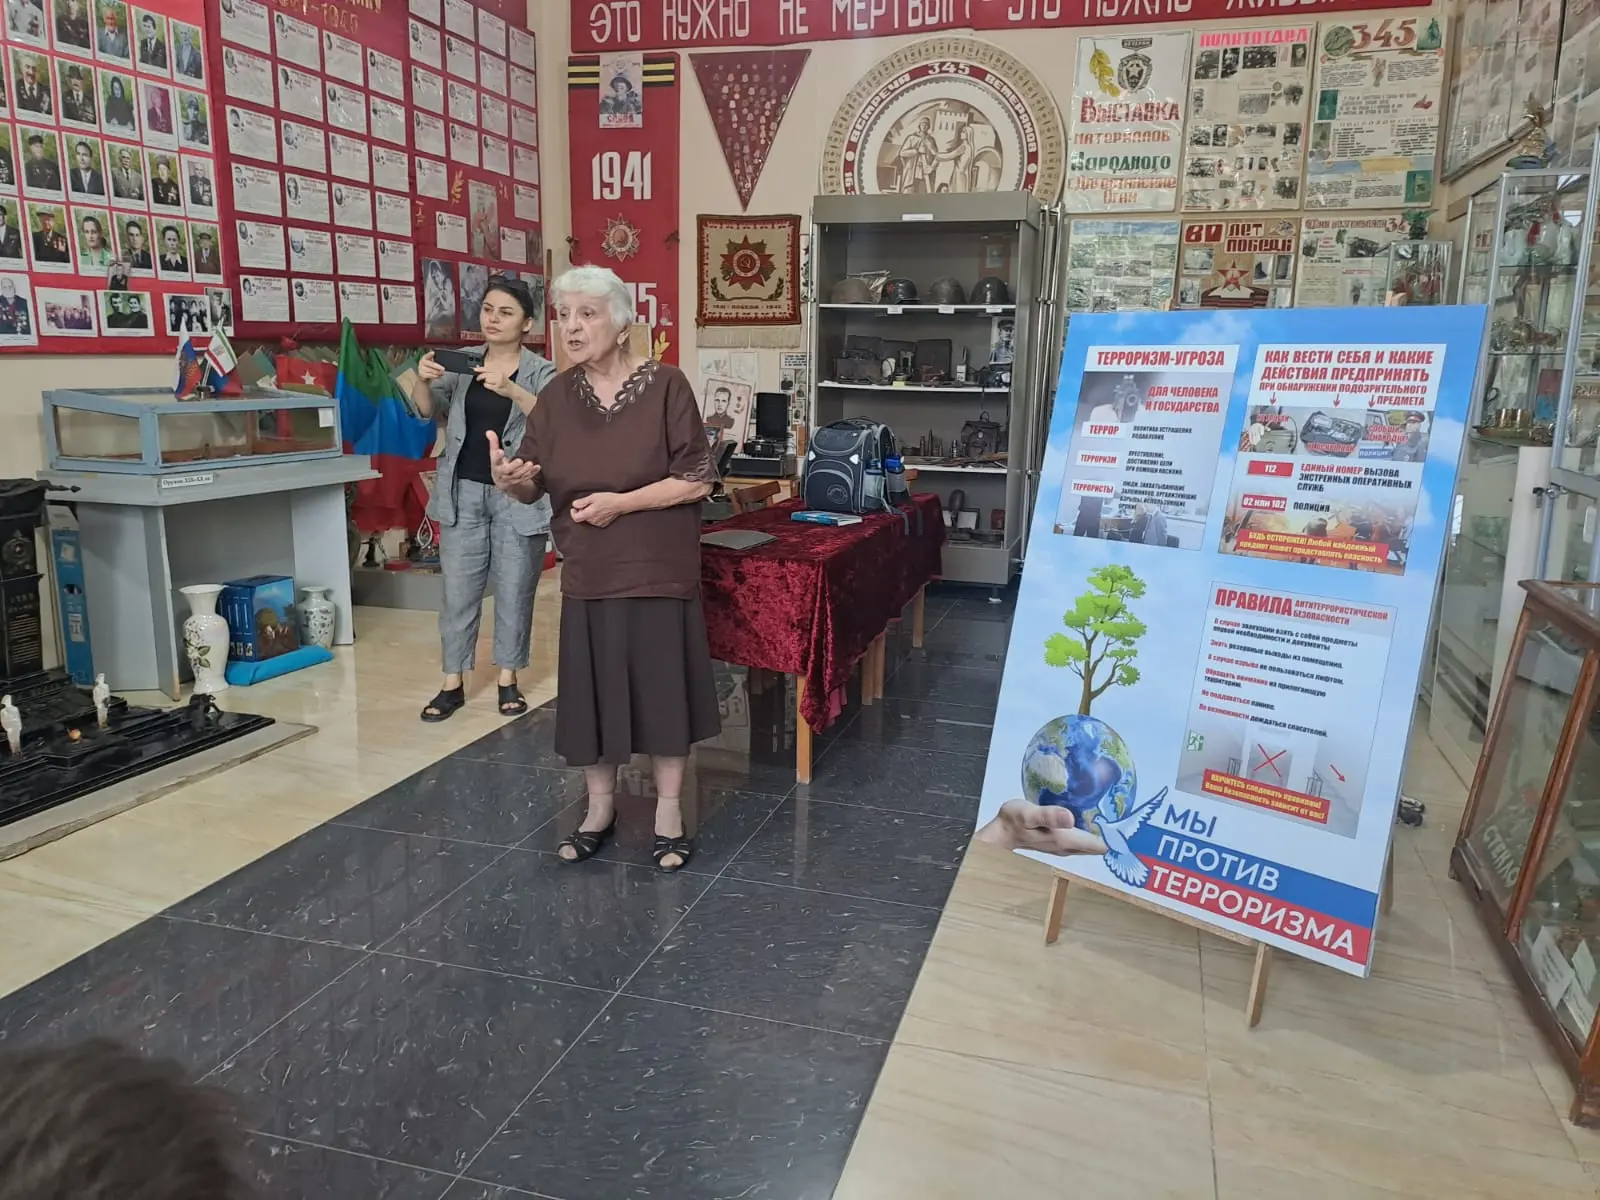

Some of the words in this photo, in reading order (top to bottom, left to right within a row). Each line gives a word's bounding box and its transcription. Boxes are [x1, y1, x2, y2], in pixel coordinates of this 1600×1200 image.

[590, 1, 641, 43] ЭТО
[663, 0, 750, 41] НУЖНО
[779, 0, 809, 35] НЕ
[1353, 18, 1417, 50] 345
[928, 62, 970, 76] 345
[984, 73, 1038, 153] ВЕТЕРАНОВ
[592, 151, 652, 200] 1941
[1097, 351, 1225, 366] ТЕРРОРИЗМ-УГРОЗА
[1265, 351, 1289, 363] КАК
[1293, 351, 1333, 364] ВЕСТИ
[1337, 351, 1371, 364] СЕБЯ
[1374, 351, 1385, 364] И
[1388, 351, 1434, 364] КАКИЕ
[1261, 365, 1328, 380] ДЕЙСТВИЯ
[1330, 367, 1430, 382] ПРЕДПРИНЯТЬ
[1148, 387, 1168, 397] ДЛЯ
[1170, 387, 1219, 398] ЧЕЛОВЕКА
[1259, 382, 1275, 391] ПРИ
[1276, 383, 1337, 392] ОБНАРУЖЕНИИ
[1338, 384, 1427, 395] ПОДОЗРИТЕЛЬНОГО
[1145, 401, 1151, 411] И
[1152, 402, 1220, 413] ГОСУДАРСТВА
[1377, 396, 1425, 406] ПРЕДМЕТА
[1089, 425, 1119, 435] ТЕРРОР
[1080, 454, 1117, 464] ТЕРРОРИЗМ
[1264, 464, 1276, 473] 112
[1300, 463, 1335, 473] ЕДИНЫЙ
[1336, 465, 1363, 474] НОМЕР
[1363, 467, 1400, 477] ВЫЗОВА
[1296, 482, 1324, 492] СЛУЖБ
[1299, 473, 1350, 485] ЭКСТРЕННЫХ
[1351, 477, 1412, 489] ОПЕРАТИВНЫХ
[1072, 483, 1114, 494] ТЕРРОРИСТЫ
[1243, 497, 1253, 506] 02
[1271, 499, 1286, 509] 102
[1293, 502, 1330, 513] ПОЛИЦИЯ
[1248, 532, 1266, 541] БУДЬ
[1215, 588, 1294, 616] ПРАВИЛА
[1295, 600, 1388, 620] АНТИТЕРРОРИСТИЧЕСКОЙ
[1293, 611, 1350, 625] БЕЗОПАСНОСТИ
[1321, 635, 1358, 648] предметы
[1164, 804, 1218, 838] МЫ
[1157, 834, 1280, 891] ПРОТИВ
[1483, 825, 1521, 888] СТЕКЛО
[1153, 865, 1354, 956] ТЕРРОРИЗМА
